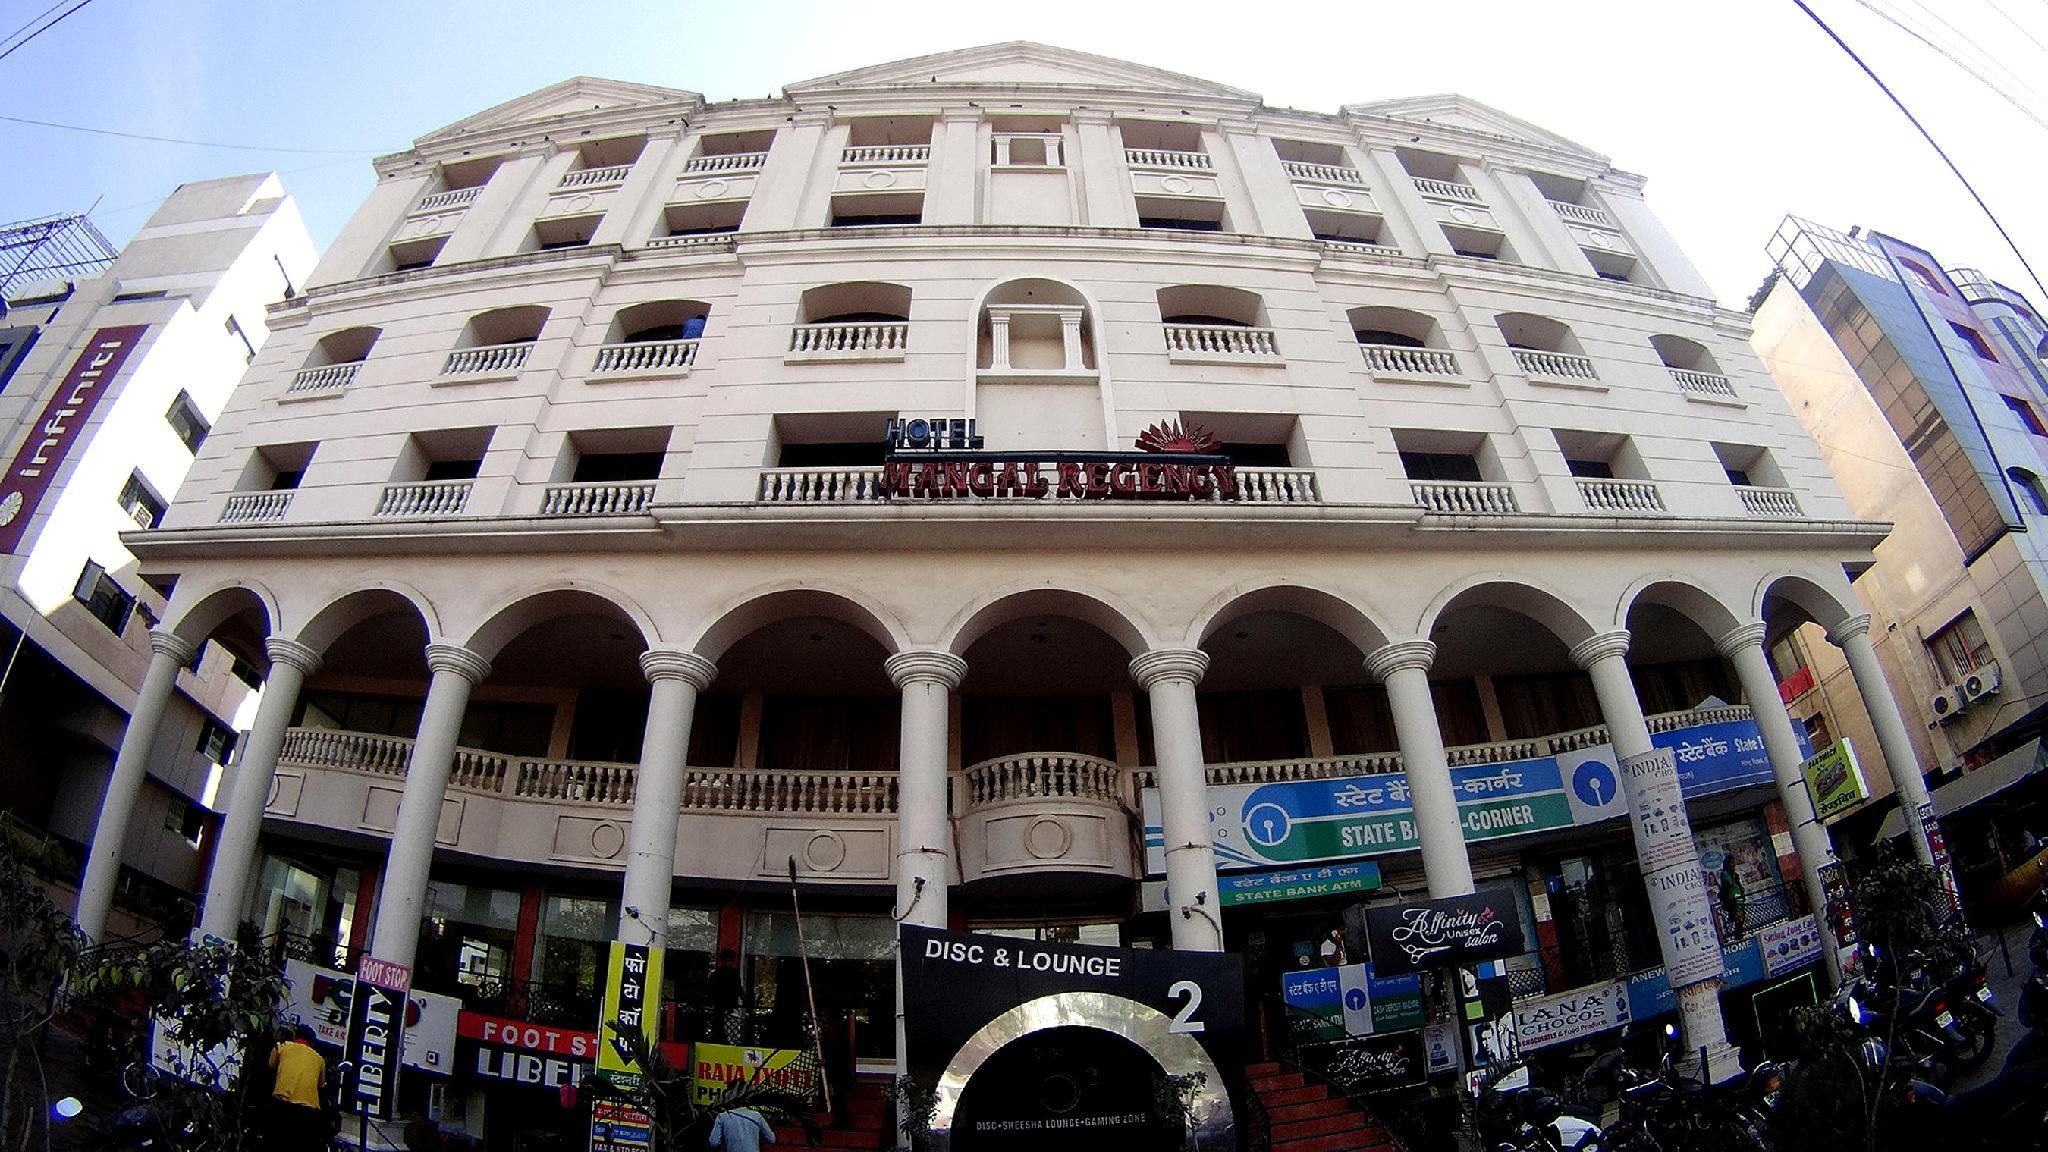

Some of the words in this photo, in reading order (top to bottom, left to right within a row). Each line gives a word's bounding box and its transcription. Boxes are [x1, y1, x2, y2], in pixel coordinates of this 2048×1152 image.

[19, 340, 122, 478] infiniti
[887, 418, 984, 451] HOTEL
[880, 462, 1048, 499] MANGAL
[1057, 462, 1238, 500] REGENCY
[1334, 783, 1384, 808] स्टेट
[1341, 821, 1397, 847] STATE
[1233, 873, 1264, 887] स्टेट
[1269, 869, 1298, 885] बैंक
[1302, 871, 1312, 882] ए
[1316, 867, 1332, 880] टी
[1339, 866, 1359, 877] एम
[1235, 889, 1280, 902] STATE
[1287, 885, 1327, 897] BANK
[1332, 879, 1362, 891] ATM
[1393, 908, 1478, 944] Affinity
[1465, 921, 1504, 948] salon
[925, 939, 985, 964] DISC
[993, 946, 1010, 968] &
[1017, 948, 1121, 977] LOUNGE
[1724, 939, 1753, 956] HOME
[361, 959, 384, 981] FOOT
[386, 967, 408, 989] STOP
[1167, 980, 1205, 1034] 2
[319, 1024, 336, 1038] TAKE
[483, 1021, 560, 1052] FOOT
[1522, 1008, 1605, 1037] CHOCOS
[1580, 1018, 1607, 1033] Products
[358, 986, 392, 1120] LIBERTY
[698, 1061, 745, 1086] RAJA
[1123, 1112, 1147, 1123] ZONE
